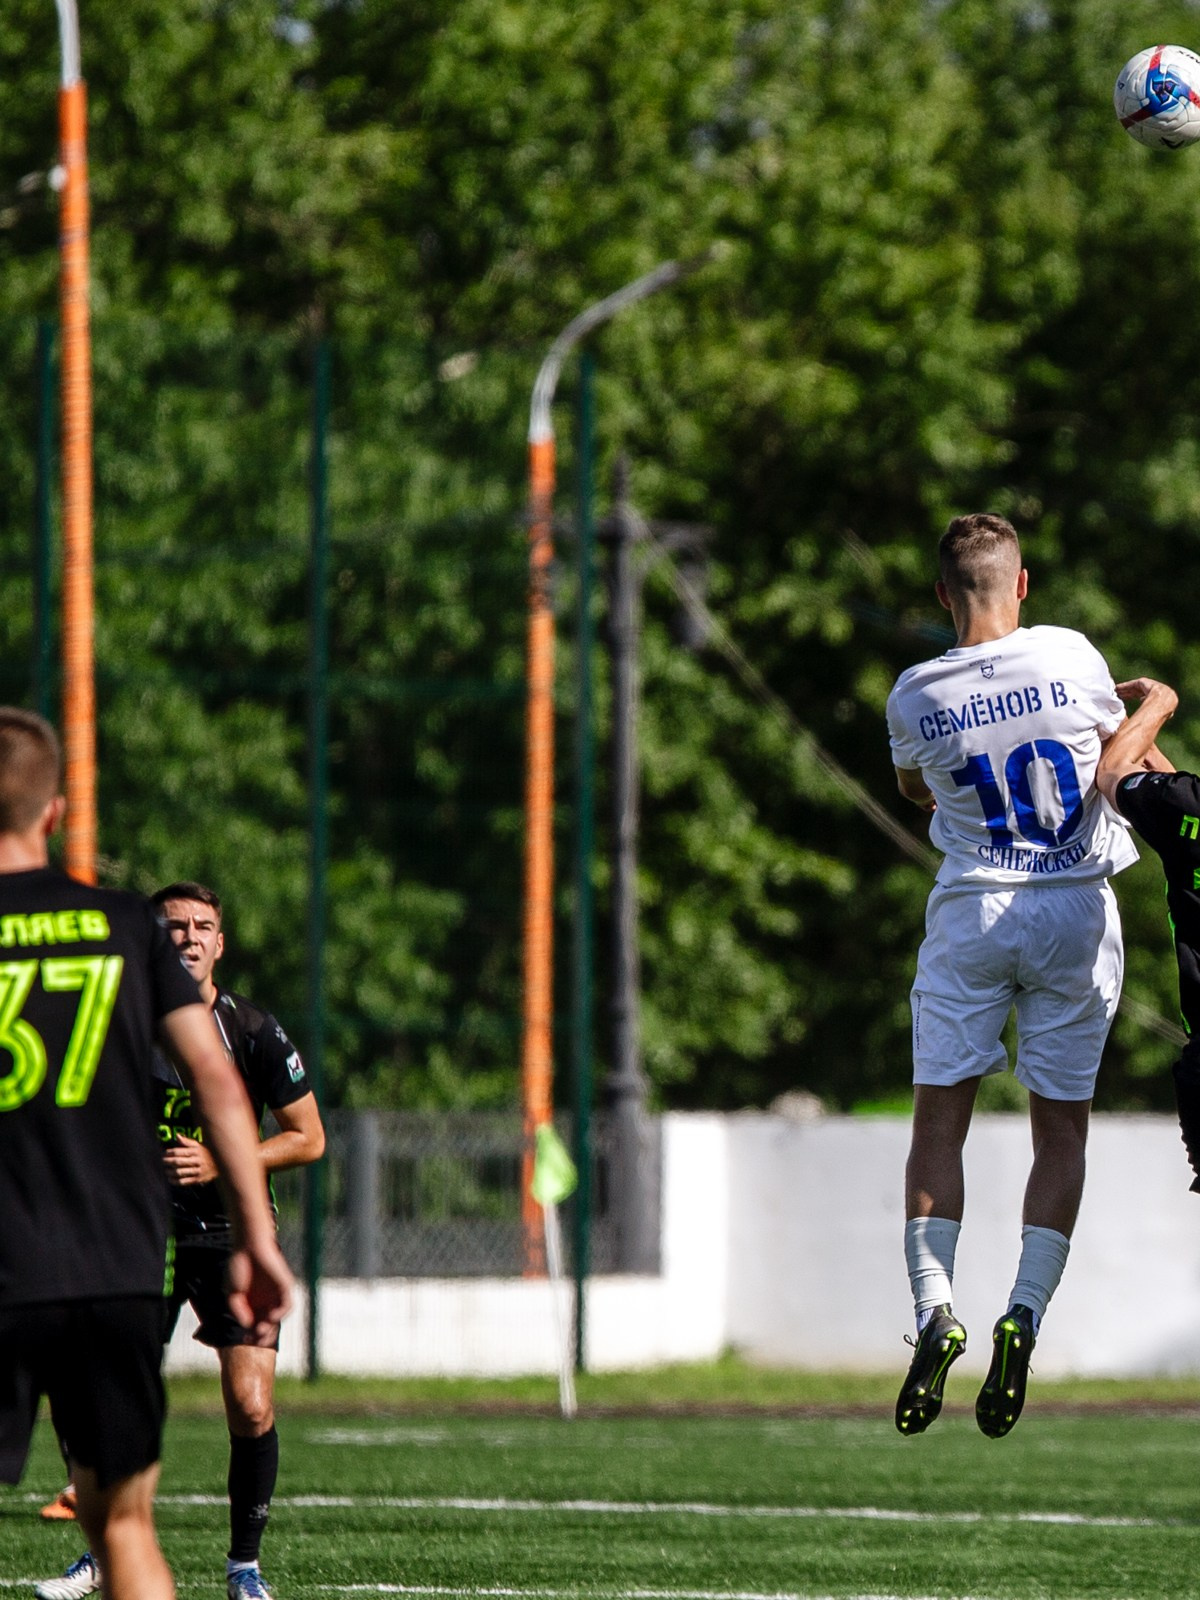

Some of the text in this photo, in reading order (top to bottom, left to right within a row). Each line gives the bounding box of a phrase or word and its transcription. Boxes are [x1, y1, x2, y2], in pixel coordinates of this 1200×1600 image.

[919, 681, 1077, 742] СЕМЁНОВ В.
[950, 738, 1084, 849] 10
